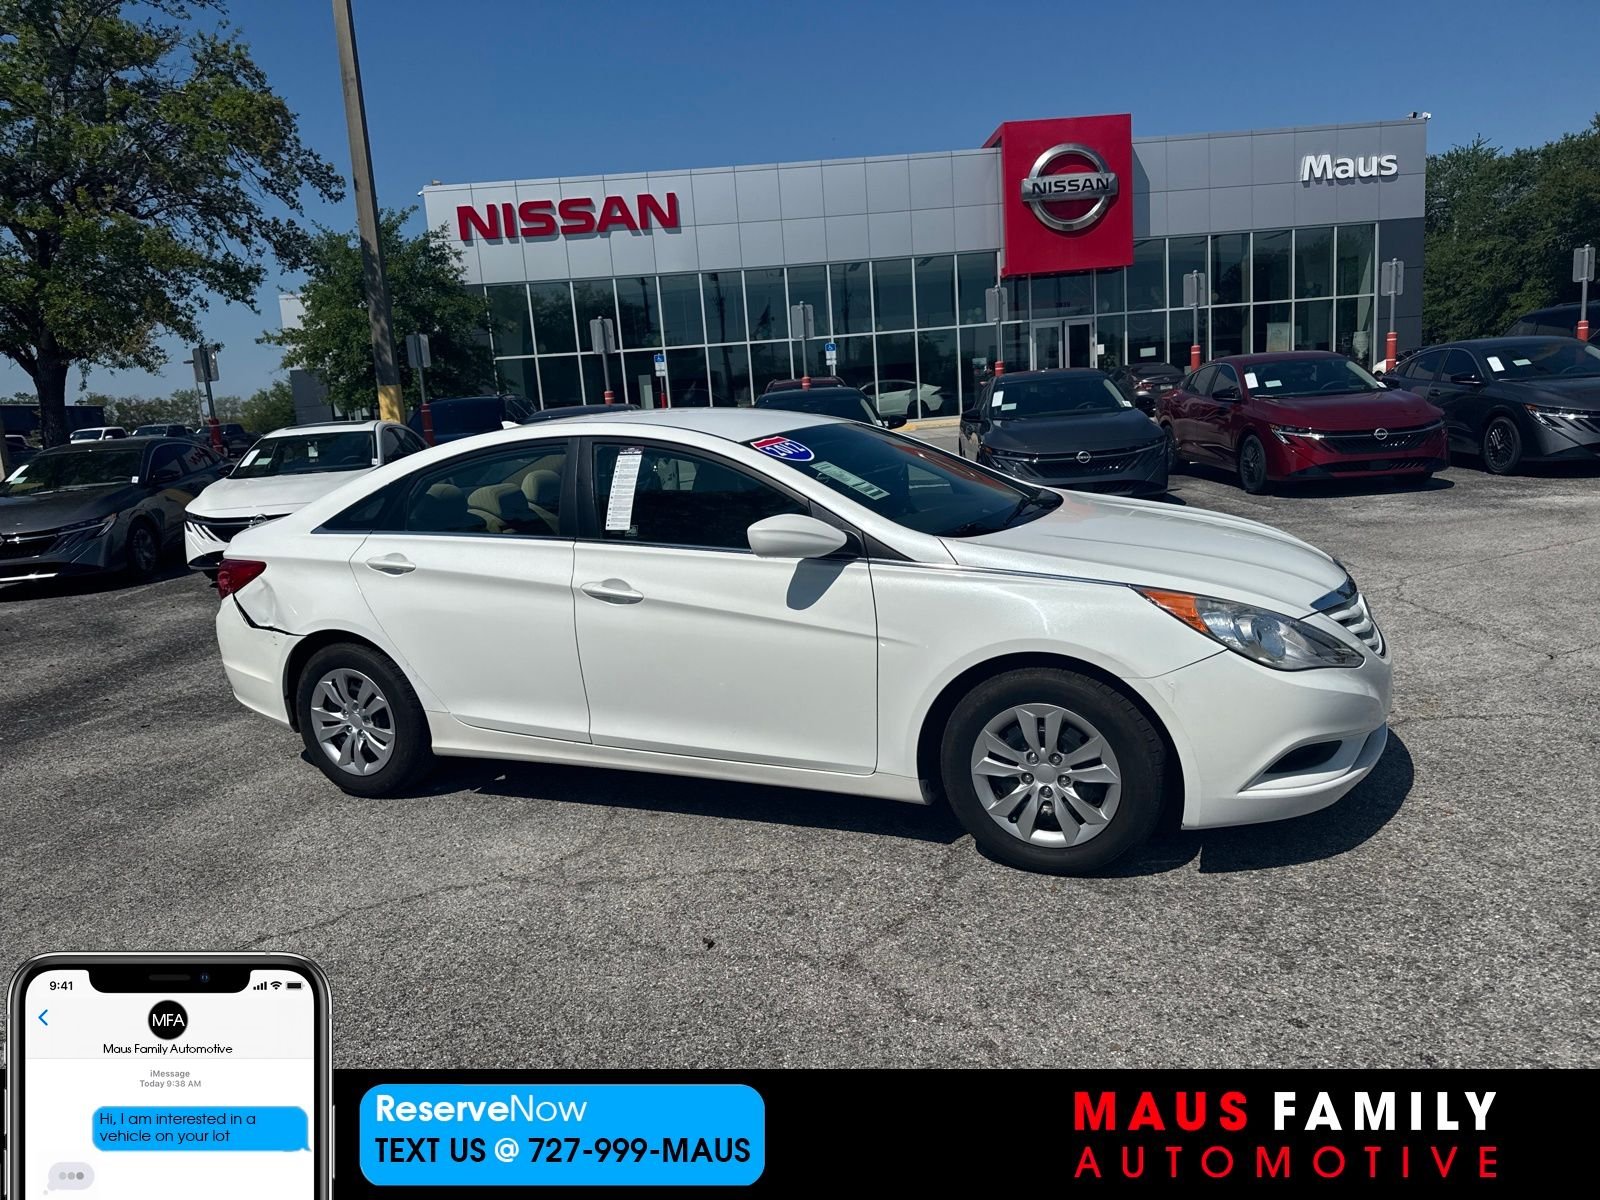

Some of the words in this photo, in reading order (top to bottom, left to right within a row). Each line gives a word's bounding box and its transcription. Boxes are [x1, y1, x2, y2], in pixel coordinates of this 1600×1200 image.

[1300, 153, 1398, 181] Maus
[1032, 177, 1109, 195] NISSAN
[457, 192, 678, 241] NISSAN
[766, 442, 806, 457] 2012
